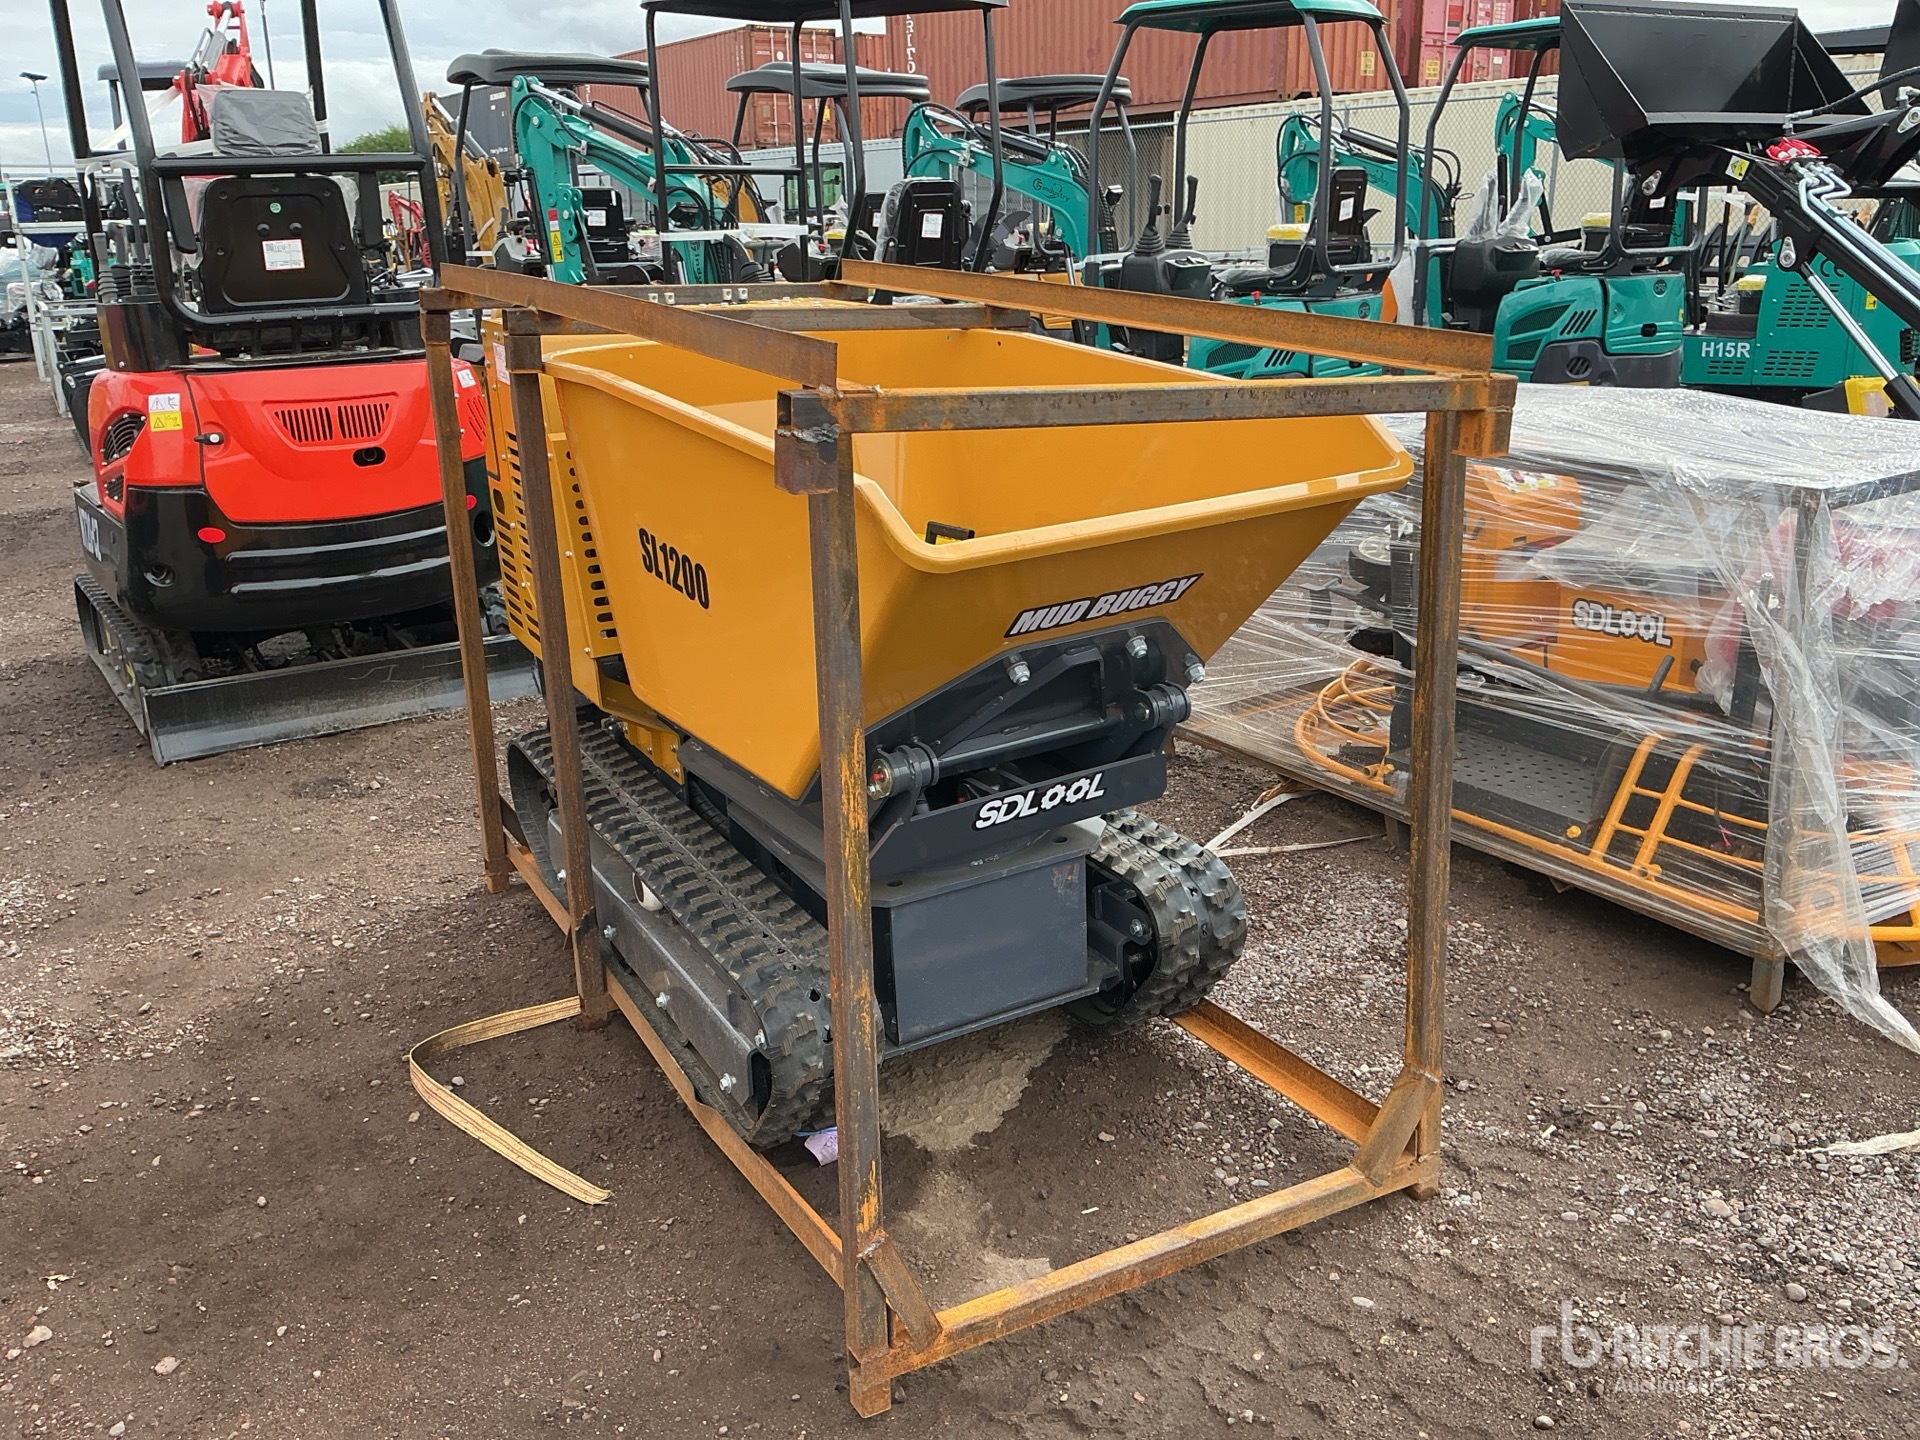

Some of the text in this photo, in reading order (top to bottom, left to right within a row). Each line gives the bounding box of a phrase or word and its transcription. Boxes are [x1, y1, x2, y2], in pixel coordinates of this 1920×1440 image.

[1701, 341, 1751, 359] H15R
[638, 527, 710, 610] SL1200
[1009, 577, 1199, 635] MUD BUGGY
[1573, 599, 1672, 647] SDLOOL
[975, 772, 1106, 830] SDLOOL
